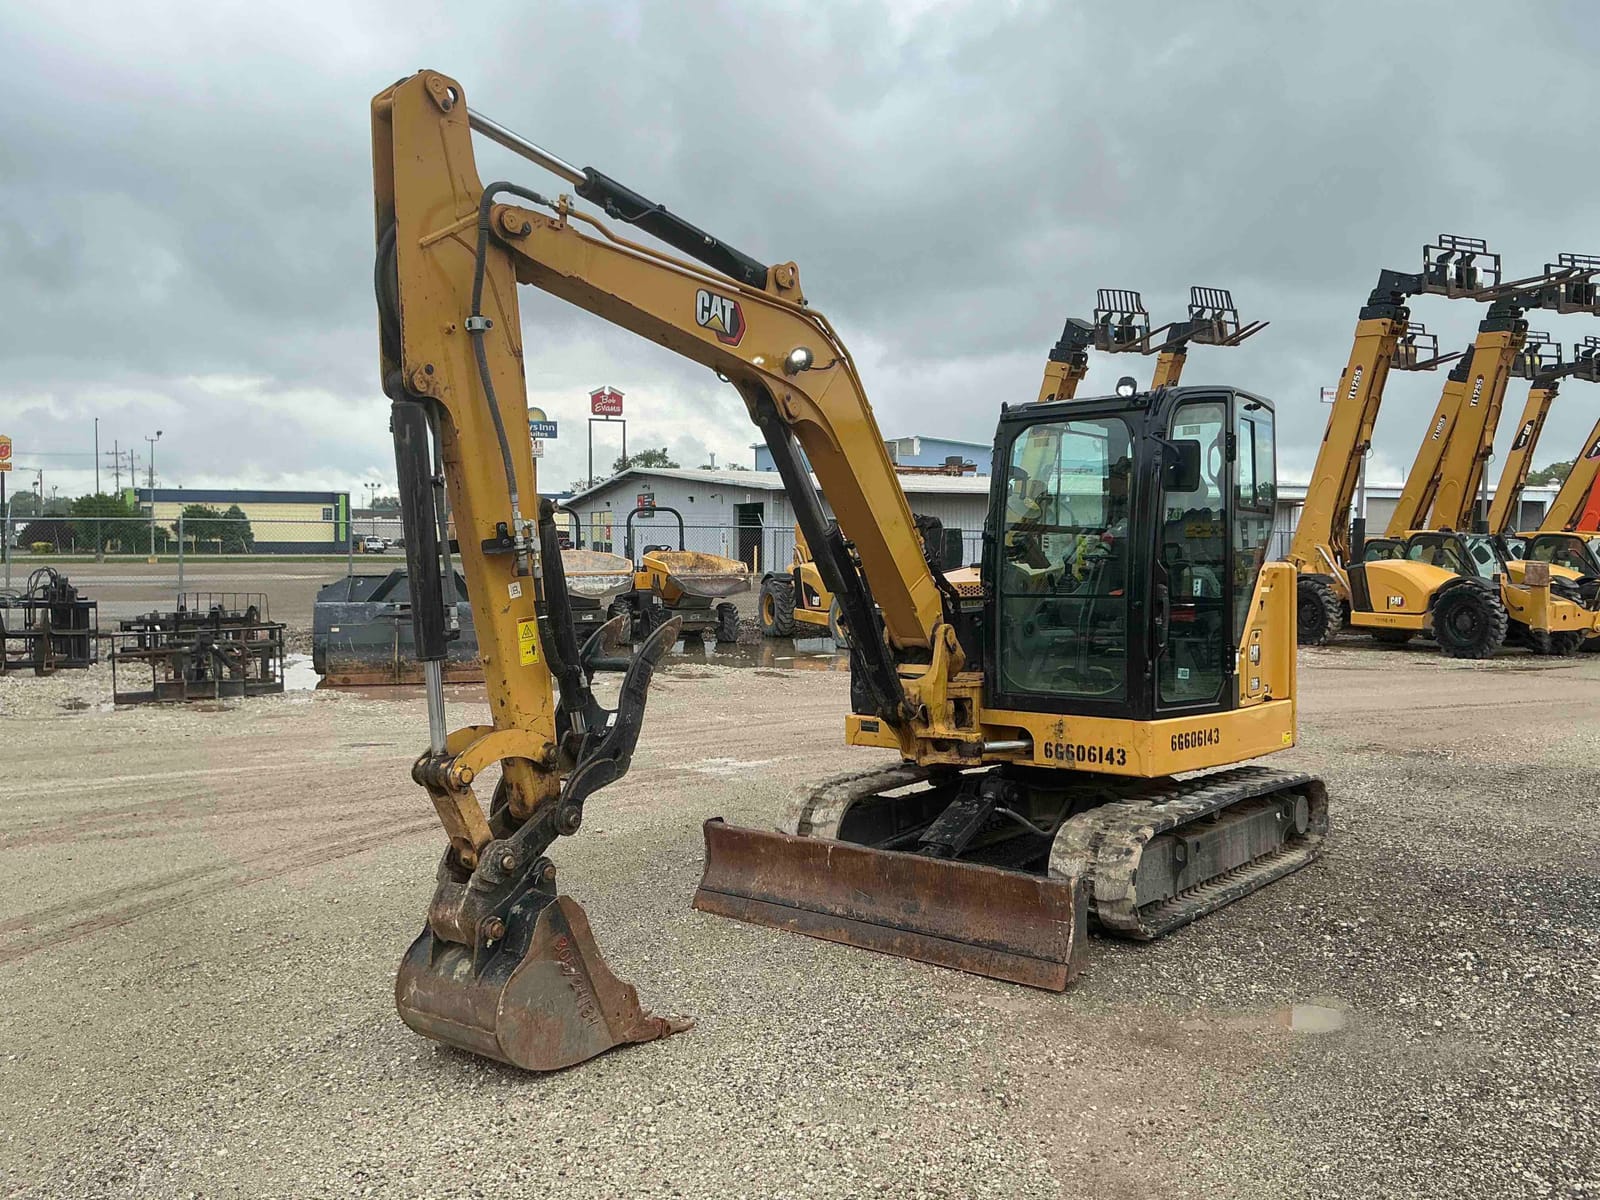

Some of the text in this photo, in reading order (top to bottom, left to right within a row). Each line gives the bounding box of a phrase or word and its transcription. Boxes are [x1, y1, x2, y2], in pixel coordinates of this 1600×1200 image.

[697, 289, 735, 335] CAT
[1348, 369, 1362, 400] TL1255
[1470, 378, 1484, 407] TL1255
[600, 395, 616, 404] Bob
[595, 402, 621, 412] Evans
[539, 423, 555, 431] Inn
[1390, 596, 1402, 605] CAT
